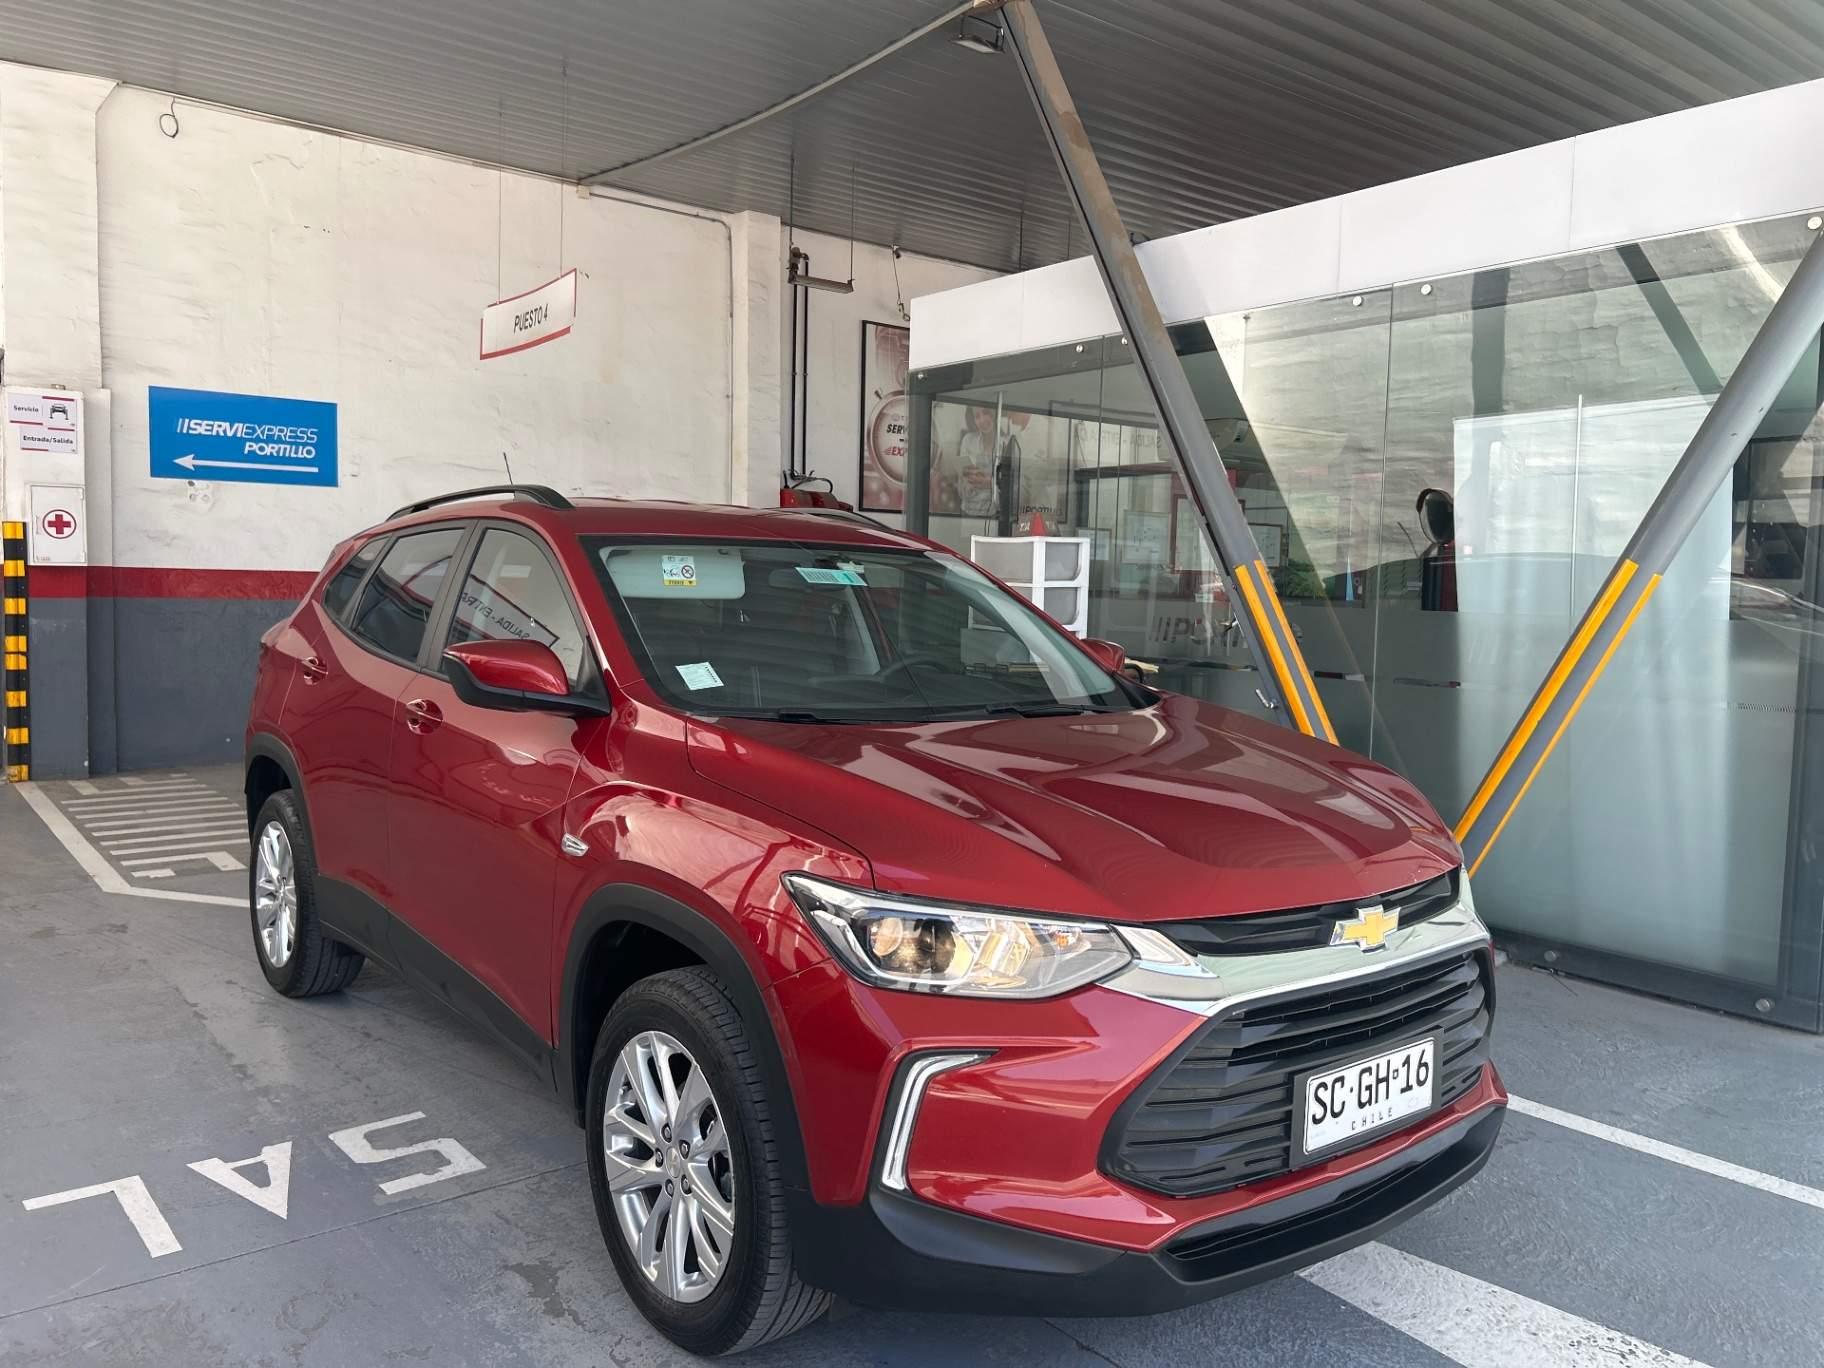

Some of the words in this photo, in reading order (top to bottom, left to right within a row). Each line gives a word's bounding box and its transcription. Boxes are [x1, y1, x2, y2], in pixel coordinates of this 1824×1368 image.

[513, 305, 543, 334] PUESTO
[543, 303, 549, 321] 4
[23, 435, 73, 444] Entrada/Salida
[244, 442, 316, 459] PORTILLO
[1351, 1107, 1393, 1130] CHILE
